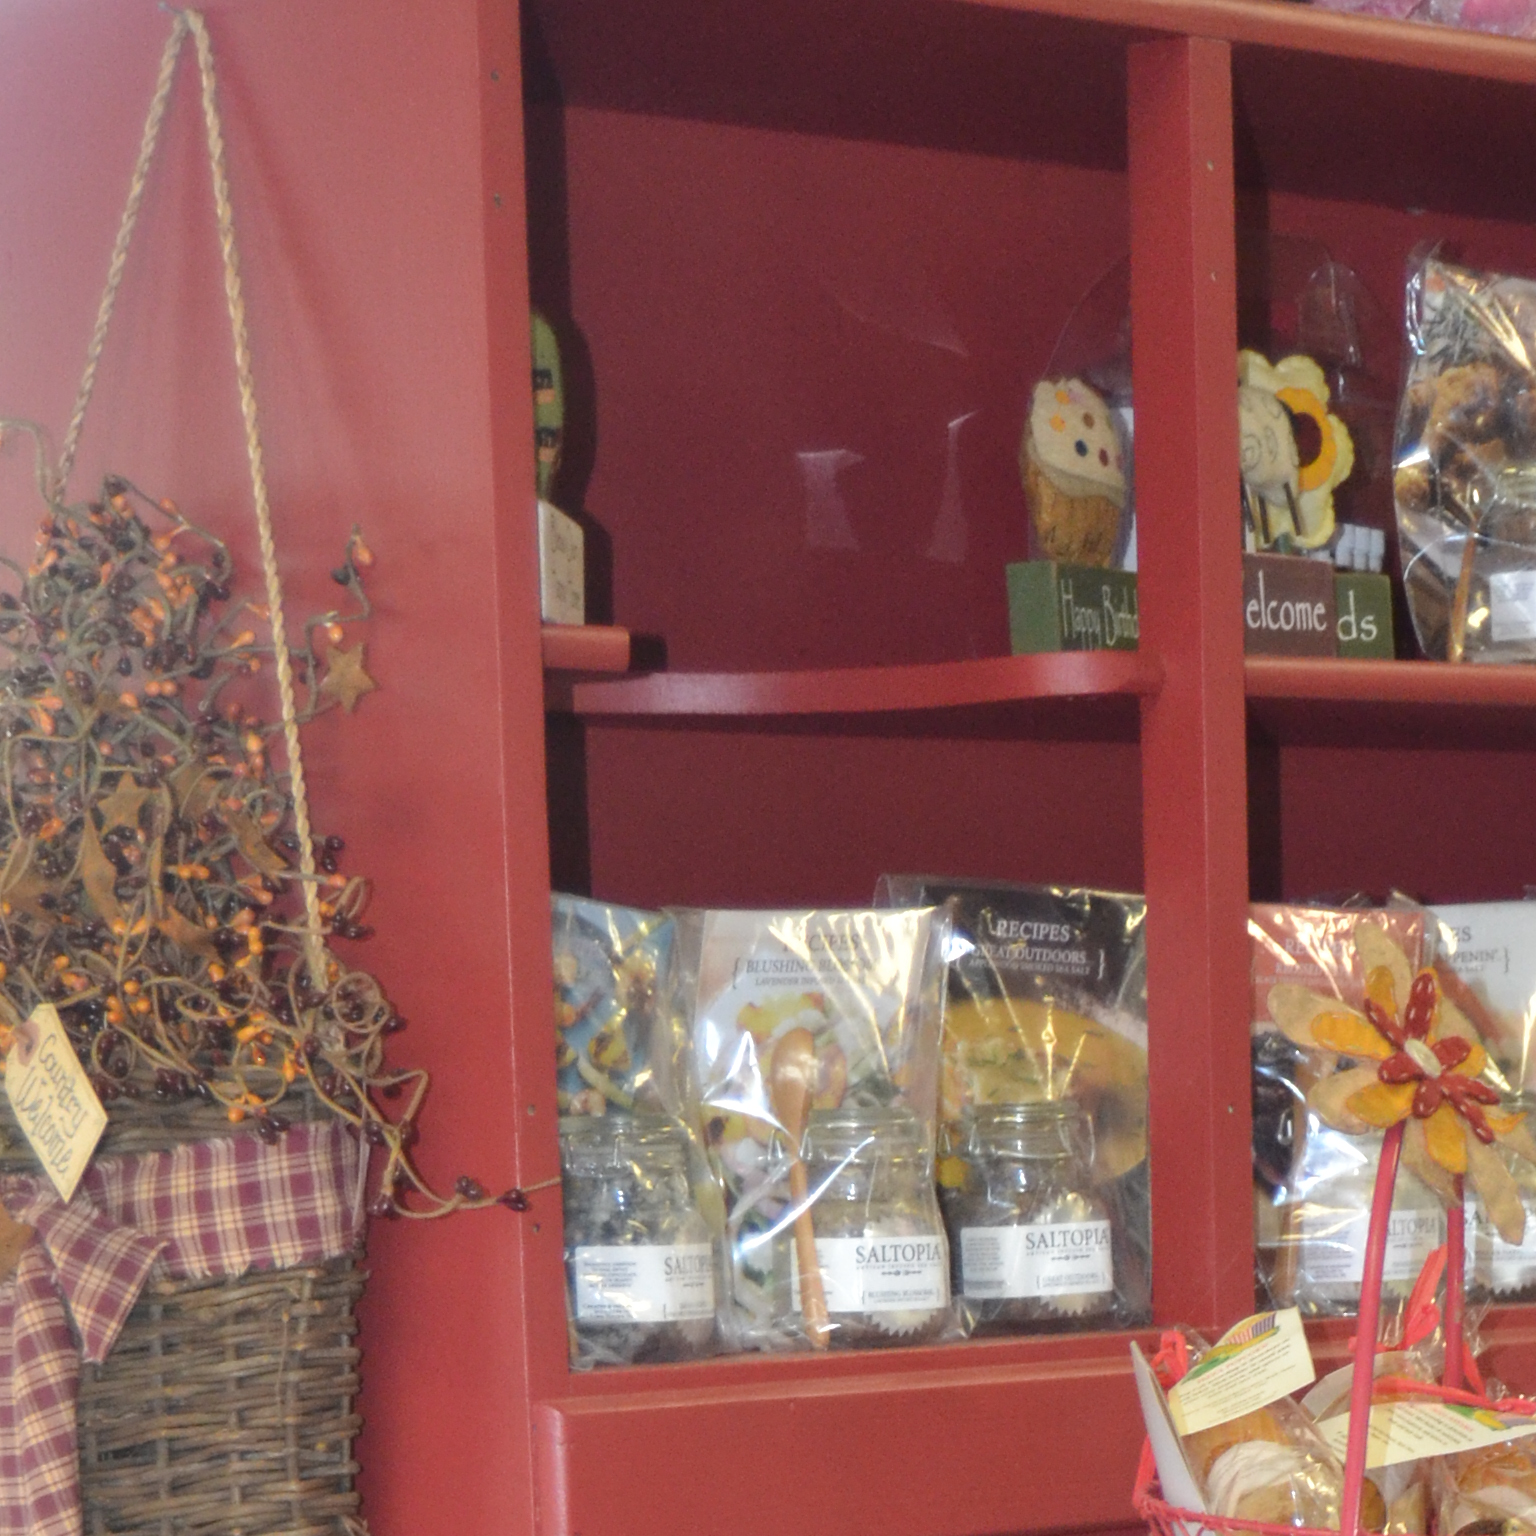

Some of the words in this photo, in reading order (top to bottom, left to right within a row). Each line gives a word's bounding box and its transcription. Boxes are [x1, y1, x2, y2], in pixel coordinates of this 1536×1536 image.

[1246, 570, 1327, 631] elcome
[1060, 578, 1102, 651] Happy
[1337, 590, 1378, 642] ds
[996, 919, 1070, 942] RECIPES
[1013, 947, 1087, 964] OUTDOORS
[1026, 1228, 1110, 1250] SALTOPIA
[856, 1242, 942, 1264] SALTOPIA
